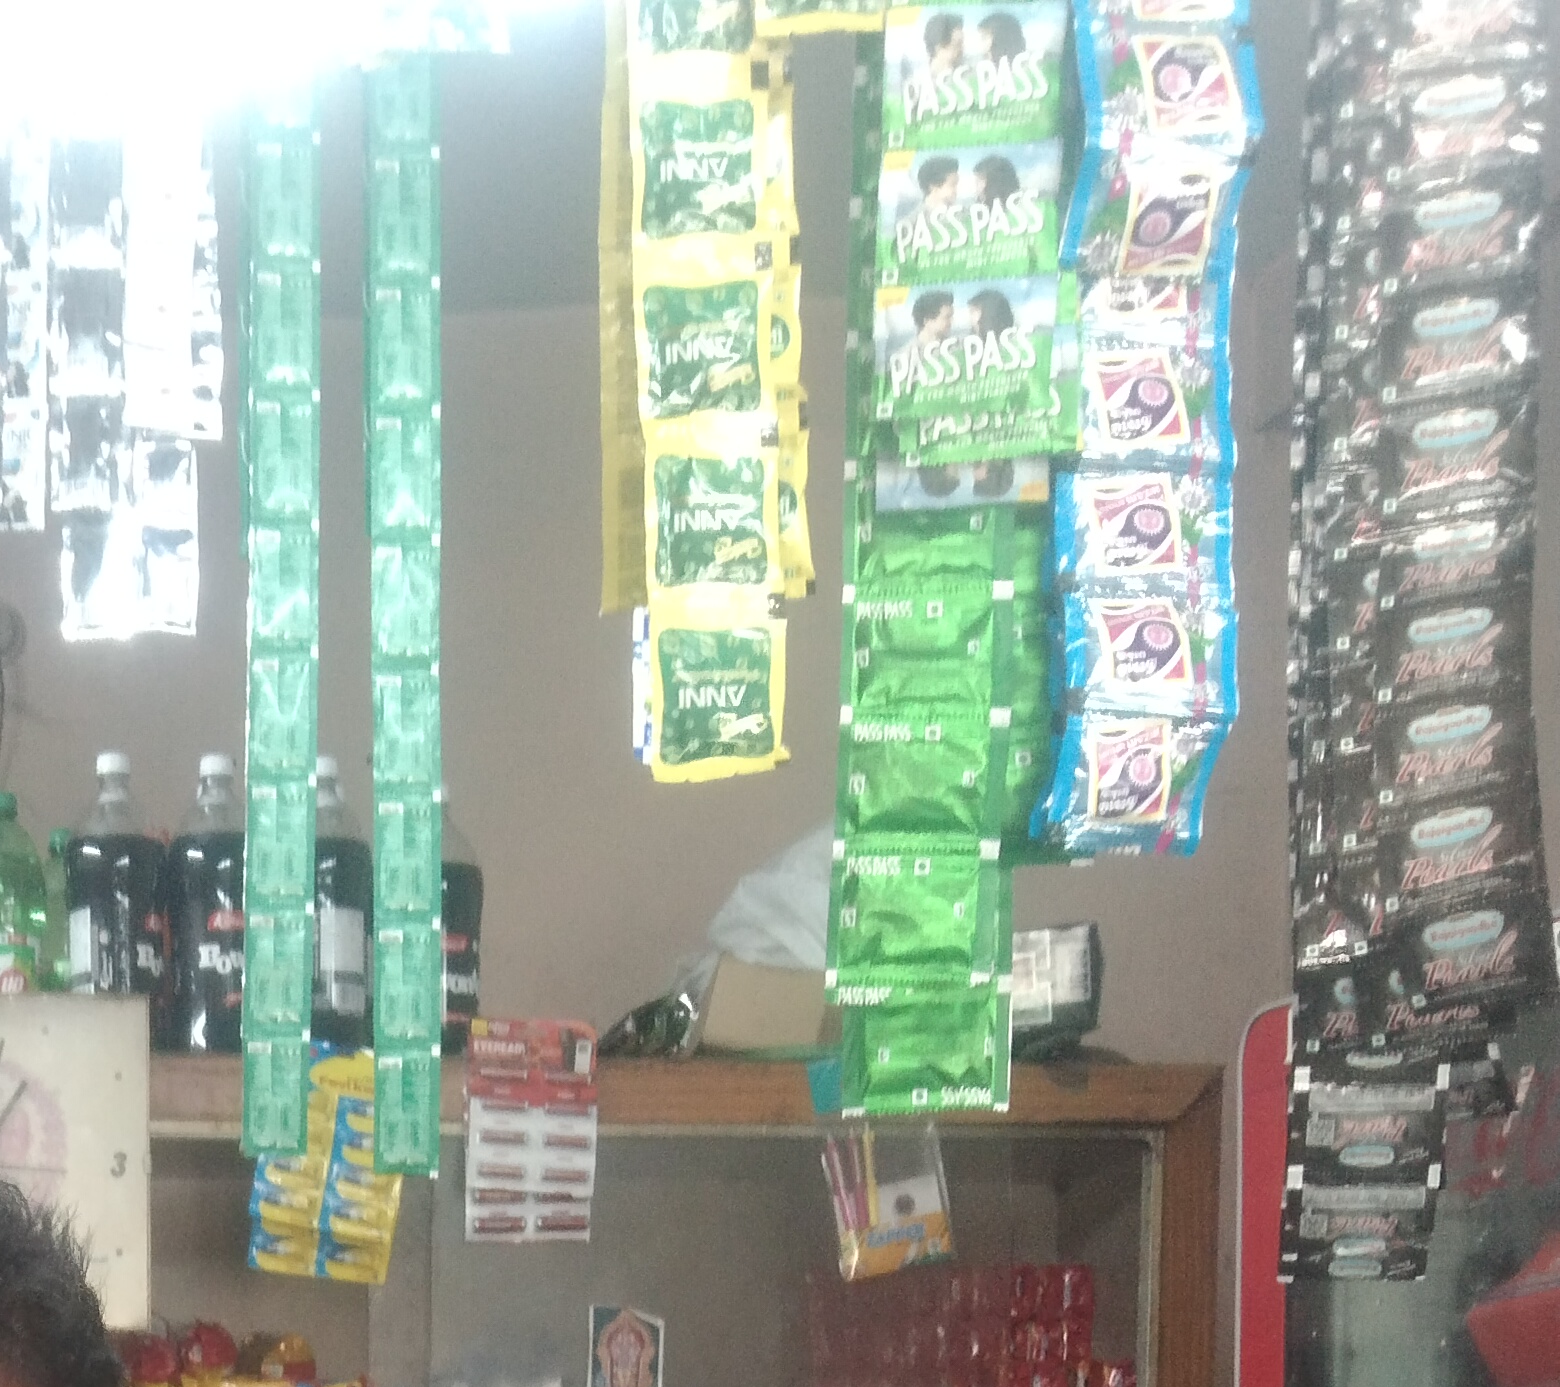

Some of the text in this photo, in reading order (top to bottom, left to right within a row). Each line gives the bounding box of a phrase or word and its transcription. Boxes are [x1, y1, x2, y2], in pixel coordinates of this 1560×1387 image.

[903, 65, 974, 125] PASS
[975, 51, 1049, 110] PASS
[896, 202, 967, 264] PASS
[969, 189, 1044, 252] PASS
[890, 337, 962, 399] PASS
[963, 326, 1037, 382] PASS
[857, 600, 913, 620] PASS PASS
[678, 684, 746, 709] ANNI
[854, 723, 911, 742] PASS PASS
[873, 857, 901, 875] PASS
[109, 1152, 127, 1178] 3
